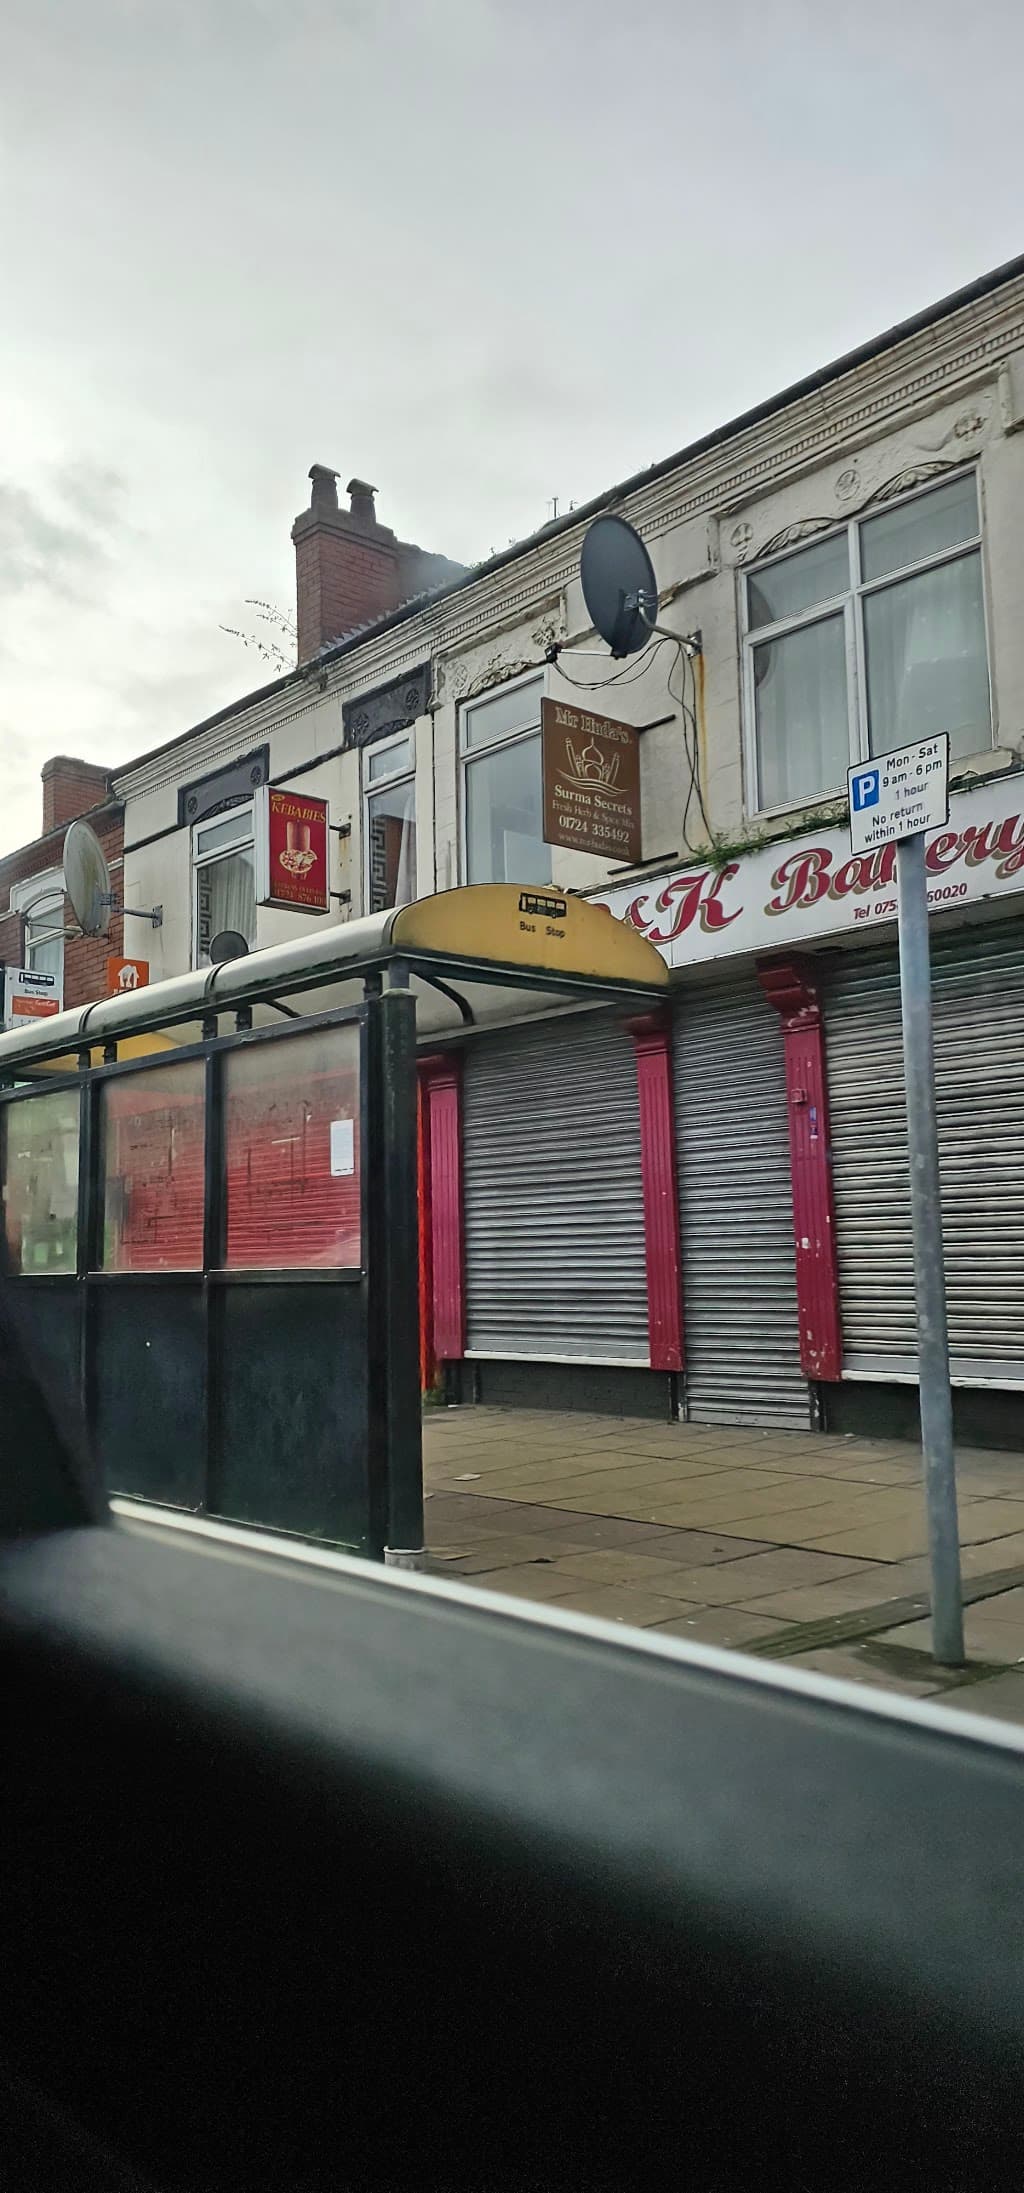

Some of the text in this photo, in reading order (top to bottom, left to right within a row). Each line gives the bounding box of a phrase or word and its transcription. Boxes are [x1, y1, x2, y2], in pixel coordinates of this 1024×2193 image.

[555, 706, 578, 729] Mr
[886, 755, 910, 772] Mon
[918, 743, 938, 759] Sat
[882, 776, 889, 788] 9
[891, 772, 908, 785] am
[915, 765, 923, 776] 6
[925, 759, 943, 775] pm
[554, 784, 633, 816] Surma Secrets
[858, 775, 876, 807] P
[895, 782, 929, 800] 1 hour
[559, 815, 630, 844] 01724 335492
[864, 814, 931, 844] within 1 hour
[872, 802, 924, 828] No return
[648, 863, 744, 946] K
[853, 904, 871, 920] Tel
[519, 920, 566, 939] Bus Stop
